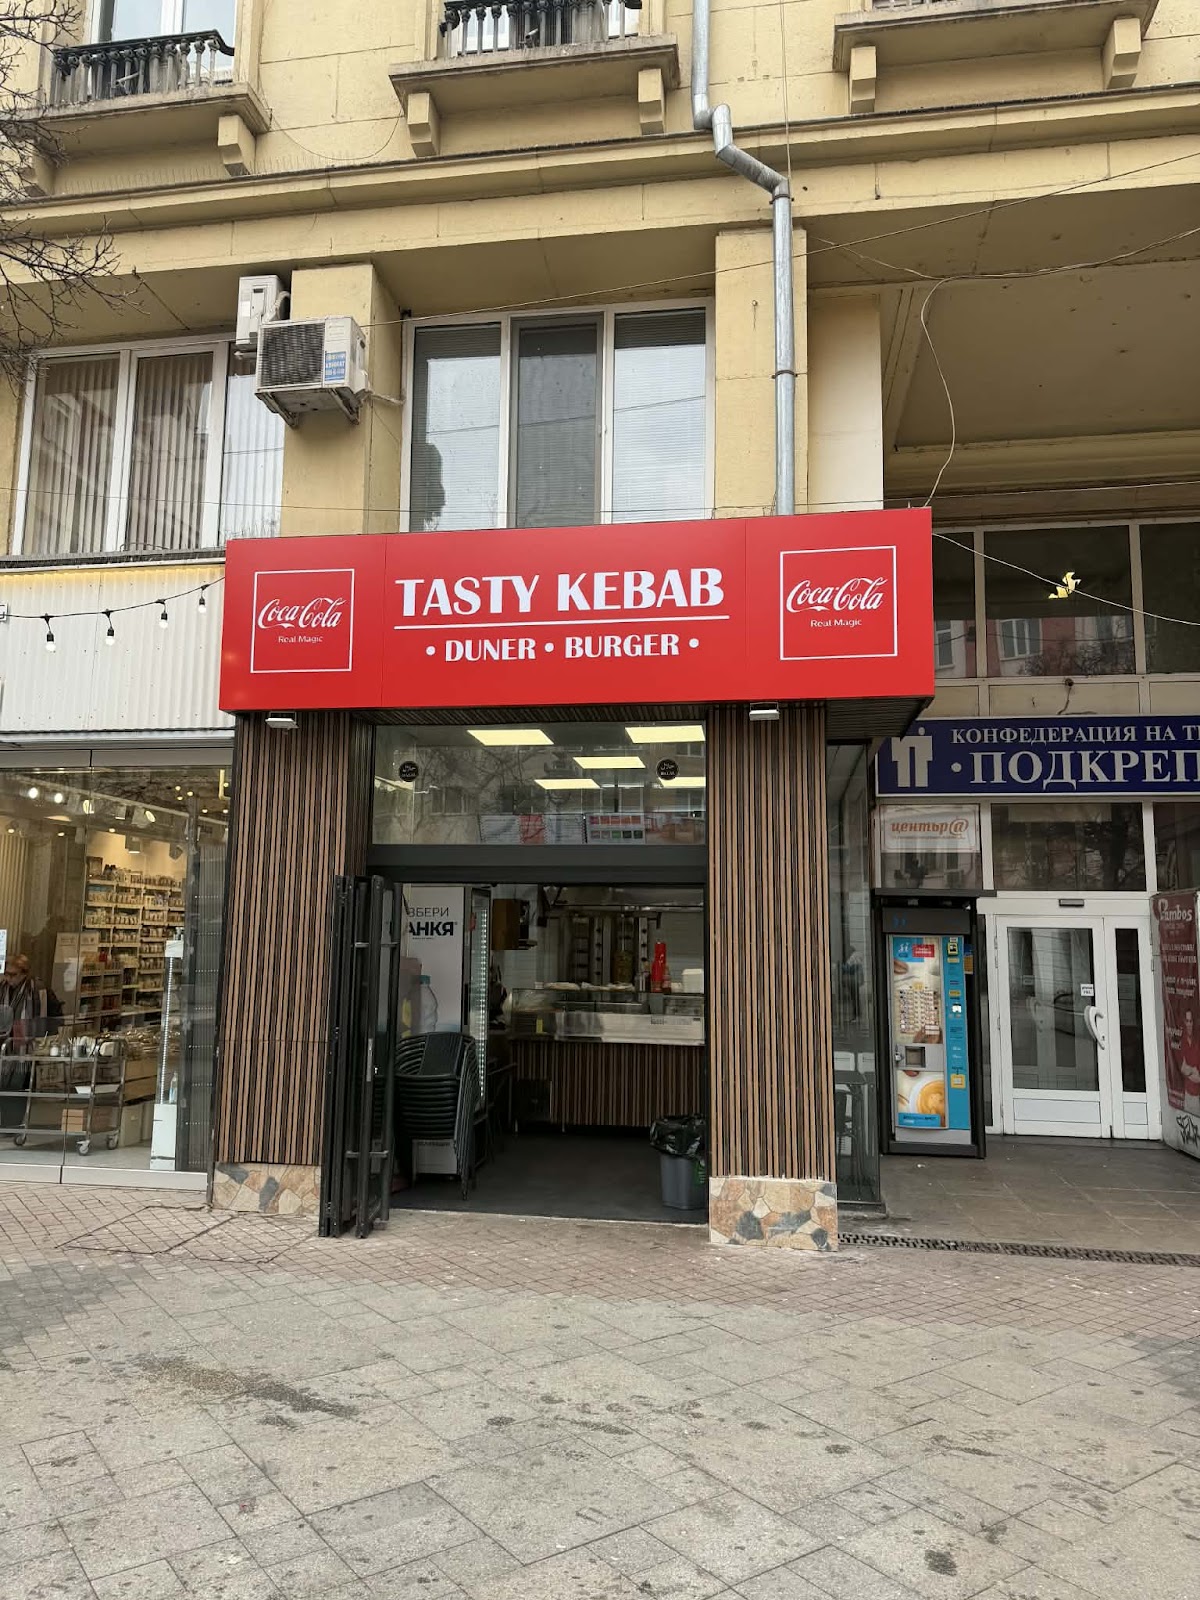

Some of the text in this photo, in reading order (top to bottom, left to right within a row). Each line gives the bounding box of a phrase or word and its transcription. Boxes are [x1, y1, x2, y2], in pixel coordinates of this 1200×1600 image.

[395, 567, 724, 617] TASTY KEBAB
[786, 577, 888, 613] Coca-Cola
[258, 598, 346, 629] Coca-Cola
[810, 618, 862, 628] Real Magic
[278, 635, 324, 644] Real Magic
[445, 633, 680, 662] DUNER BURGER
[951, 725, 1137, 746] КОНФЕДЕРАЦИЯ
[1144, 725, 1176, 741] НА
[969, 749, 1200, 791] ПОДКРЕП
[408, 906, 449, 918] ЗБЕРИ
[408, 921, 454, 936] АНКЯ
